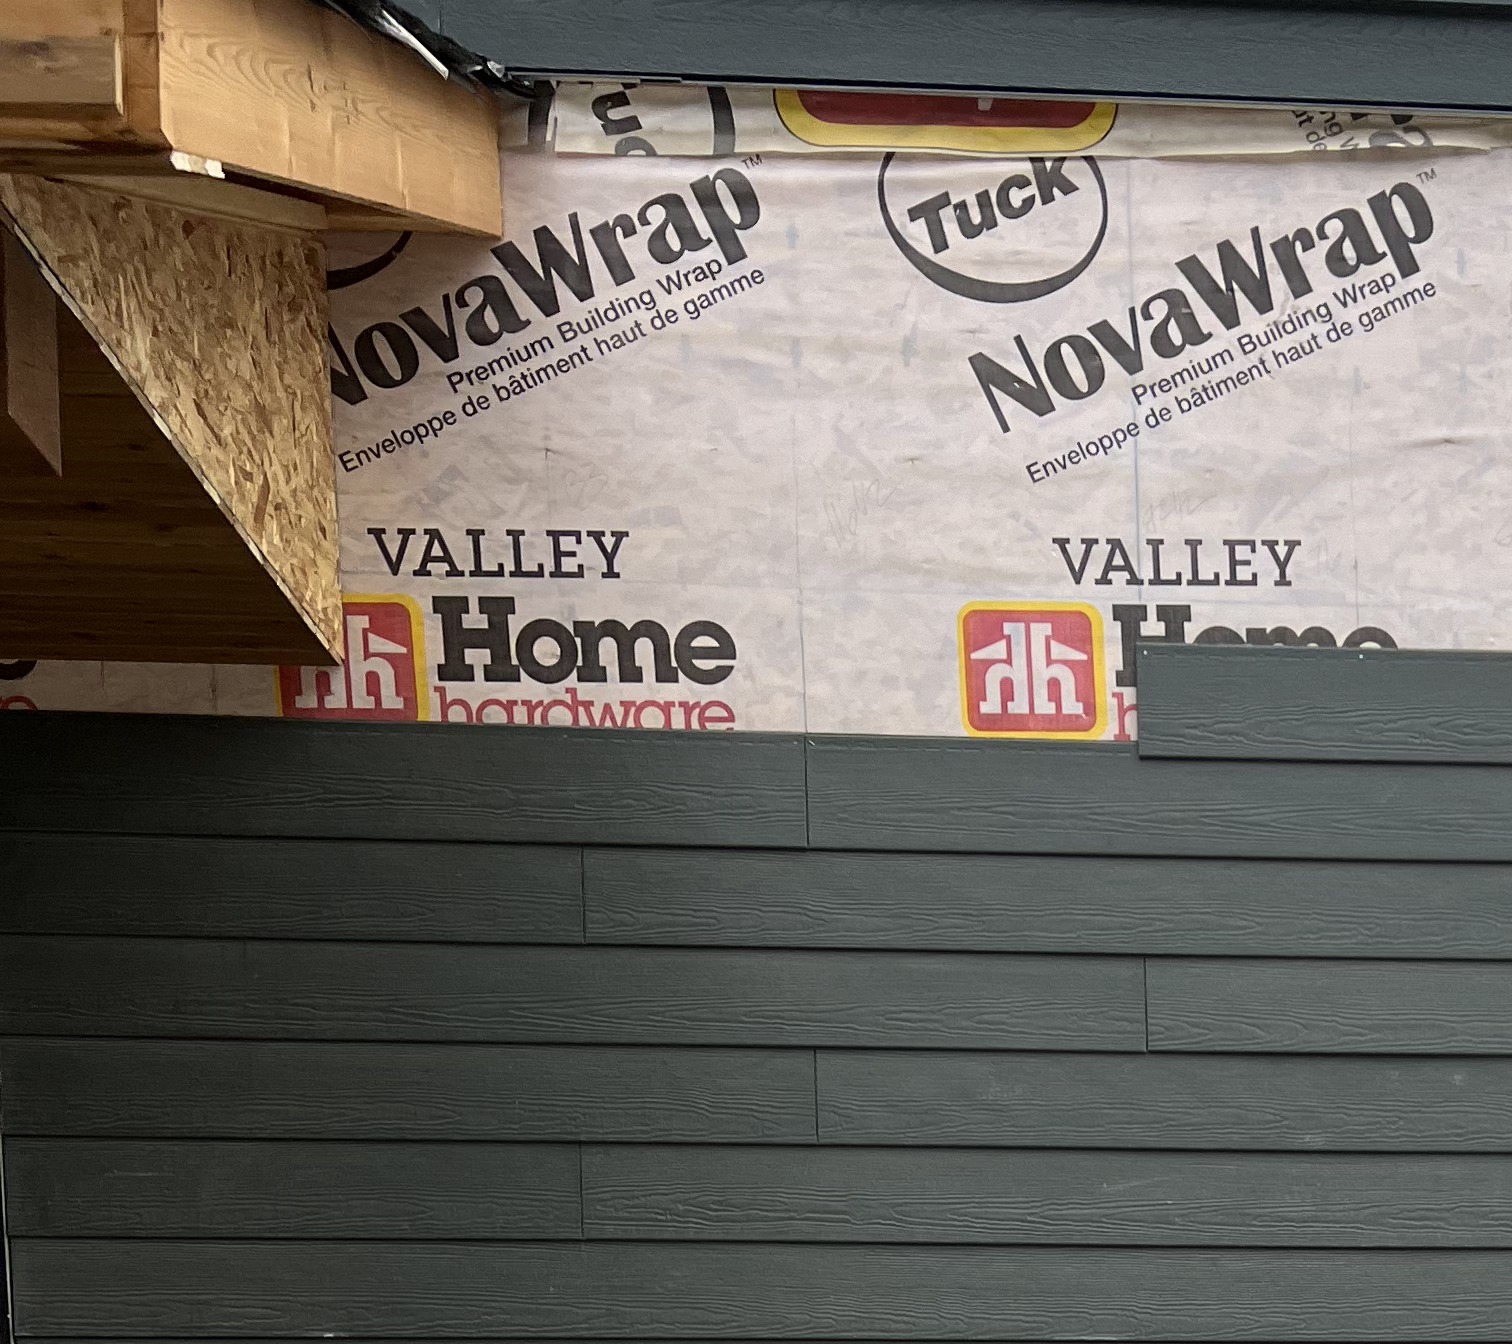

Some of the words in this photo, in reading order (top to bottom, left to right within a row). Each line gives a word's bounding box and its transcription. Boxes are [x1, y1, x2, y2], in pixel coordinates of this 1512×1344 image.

[907, 156, 1079, 254] Tuck
[338, 409, 458, 473] Enveloppe
[461, 389, 491, 417] de
[498, 344, 595, 403] bâtiment
[597, 320, 647, 362] haut
[650, 308, 679, 332] de
[683, 268, 766, 321] gamme
[446, 335, 555, 393] Premium
[555, 286, 656, 344] Building
[656, 257, 723, 298] Wrap
[1131, 346, 1234, 406] Premium
[1236, 302, 1332, 355] Building
[1333, 270, 1397, 313] Wrap
[1026, 419, 1140, 484] Enveloppe
[1144, 403, 1173, 430] de
[1179, 355, 1271, 414] bâtiment
[1275, 334, 1321, 370] haut
[1326, 318, 1354, 345] de
[1358, 280, 1437, 333] gamme
[367, 527, 630, 579] VALLEY
[1051, 537, 1302, 587] VALLEY
[432, 595, 737, 685] Home
[433, 686, 736, 731] hardware
